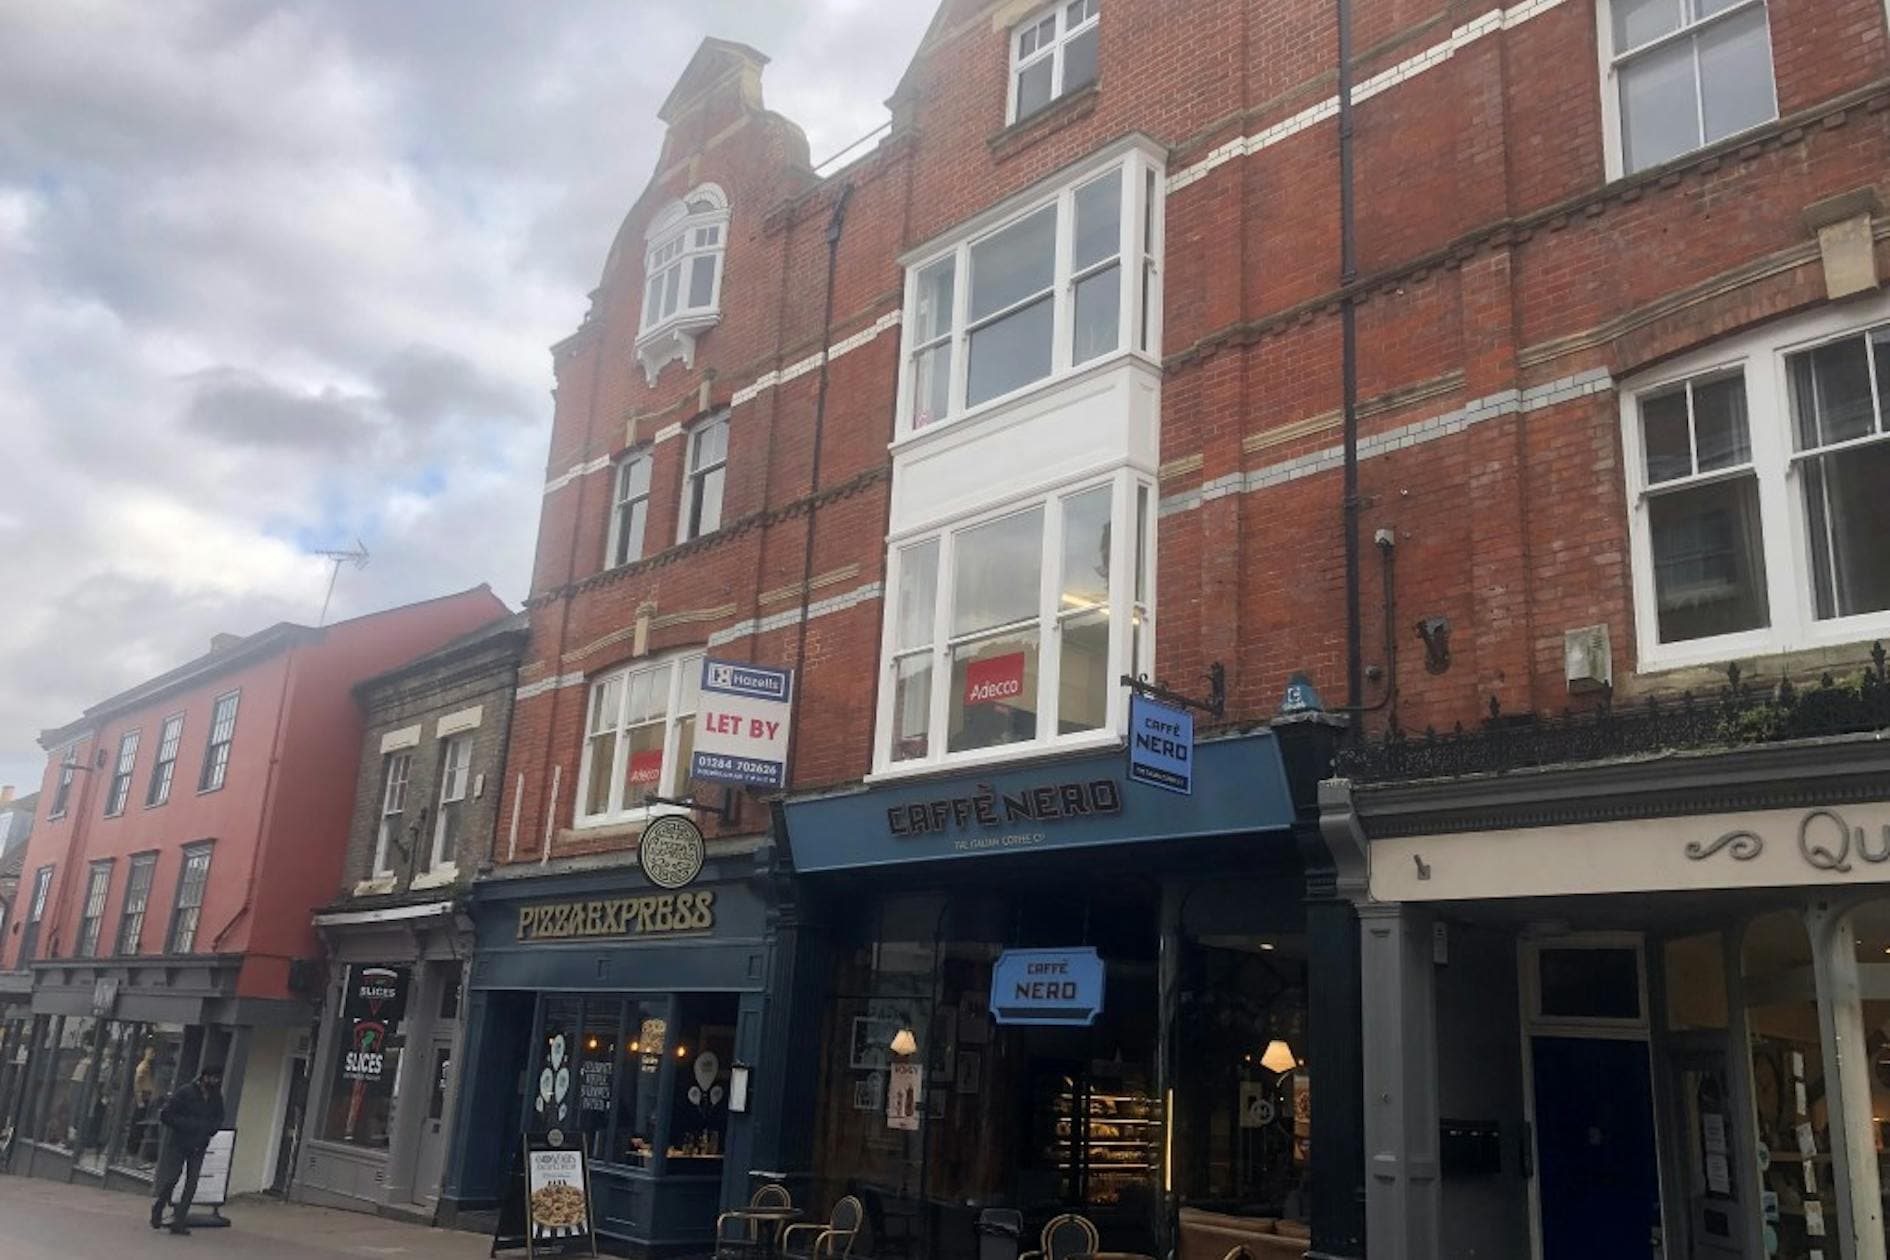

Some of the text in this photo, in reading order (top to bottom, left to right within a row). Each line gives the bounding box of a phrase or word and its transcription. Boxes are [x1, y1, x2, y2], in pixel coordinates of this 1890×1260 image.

[734, 674, 779, 690] Hazells
[970, 680, 1018, 700] Adecco
[706, 712, 779, 740] LET BY
[1136, 731, 1188, 762] NERO
[699, 756, 732, 769] 01284
[736, 761, 777, 776] 702626
[887, 780, 1121, 837] CAFFÈ NERO
[360, 986, 396, 998] SLICES
[1015, 982, 1077, 999] NERO
[345, 1052, 383, 1074] SLICES
